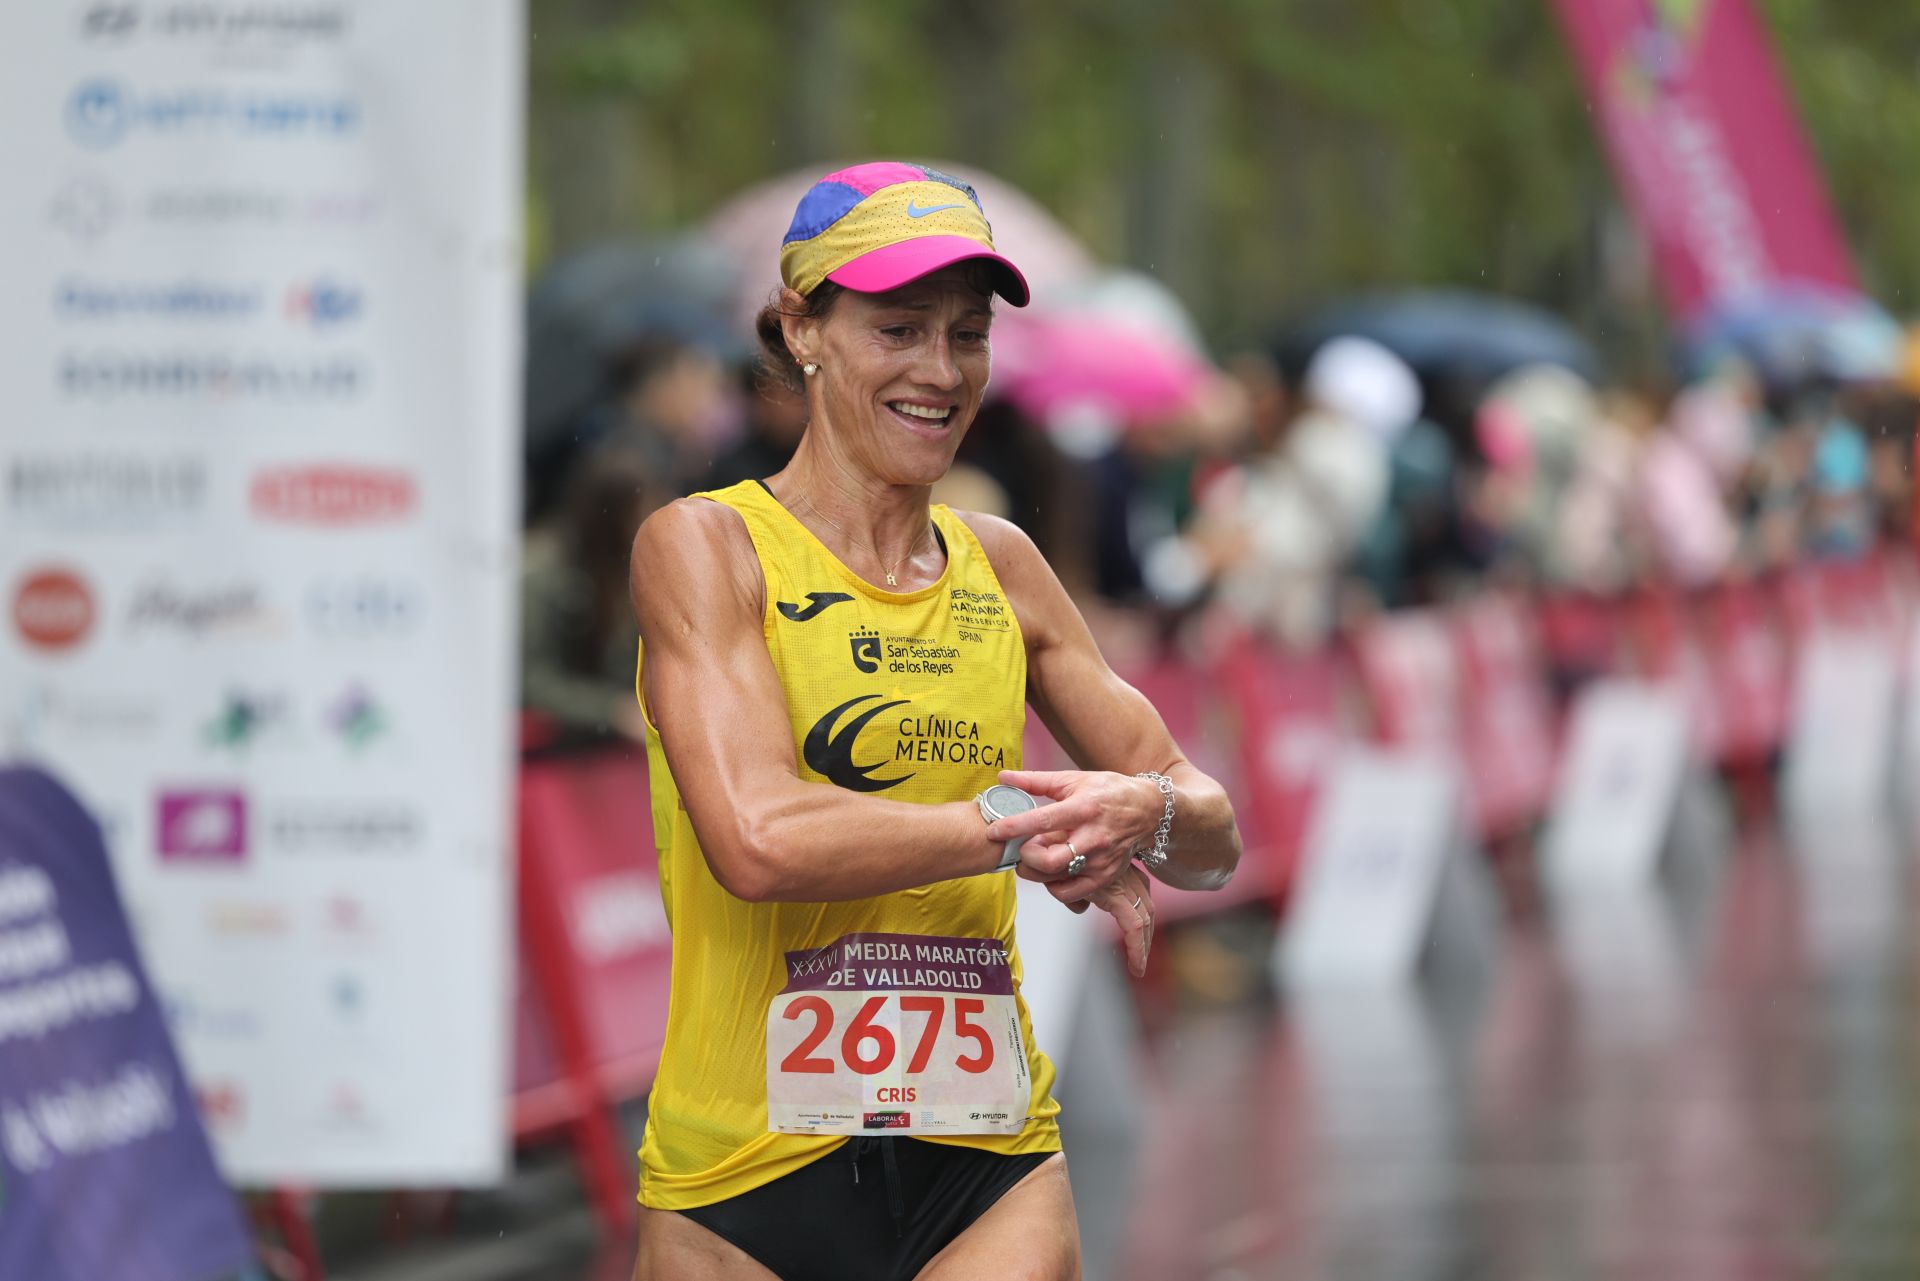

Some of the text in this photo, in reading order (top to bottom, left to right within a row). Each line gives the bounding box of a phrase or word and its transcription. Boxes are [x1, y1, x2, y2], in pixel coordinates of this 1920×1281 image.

[951, 602, 1005, 616] HATHAWAY
[958, 630, 983, 643] SPAIN
[887, 644, 960, 658] San Sebastián
[889, 659, 954, 677] de los Reyes
[899, 714, 979, 741] CLÍNICA
[895, 739, 1005, 769] MENORCA
[792, 942, 1006, 979] XXXVI MEDIA MARATÓN
[826, 967, 982, 989] DE VALLADOLID
[780, 995, 994, 1075] 2675
[876, 1087, 917, 1103] CRIS
